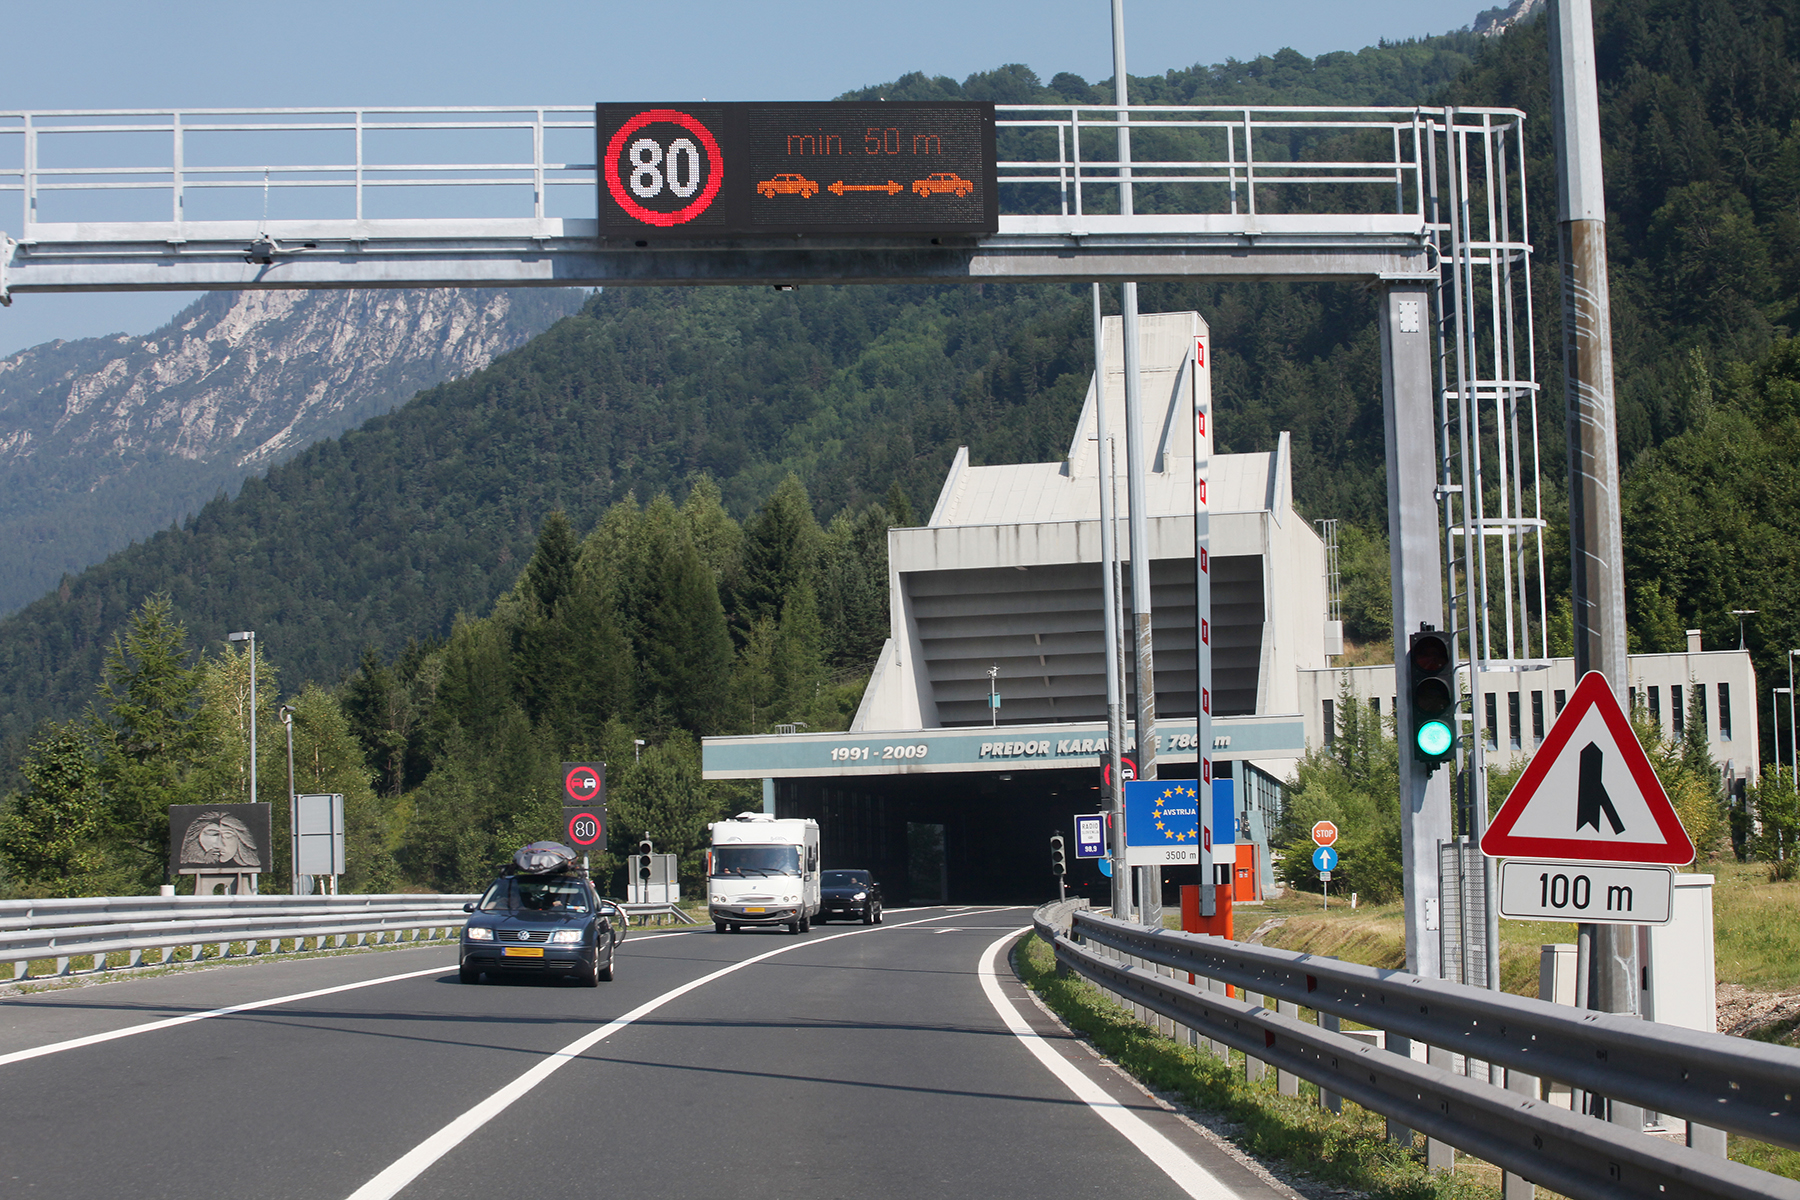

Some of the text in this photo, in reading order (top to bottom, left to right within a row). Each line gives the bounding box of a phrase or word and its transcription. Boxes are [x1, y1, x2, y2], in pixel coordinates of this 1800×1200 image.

[787, 128, 941, 155] min. 50 m
[629, 138, 700, 198] 80
[831, 746, 870, 761] 1991
[881, 744, 928, 760] 2009
[980, 740, 1051, 756] PREDOR
[1215, 735, 1231, 746] m
[1163, 808, 1196, 816] AVSTRIJA
[576, 821, 595, 837] 80
[1082, 822, 1099, 830] RADIO
[1316, 829, 1333, 838] STOP
[1165, 850, 1197, 860] 3500 m
[1540, 873, 1633, 912] 100 m
